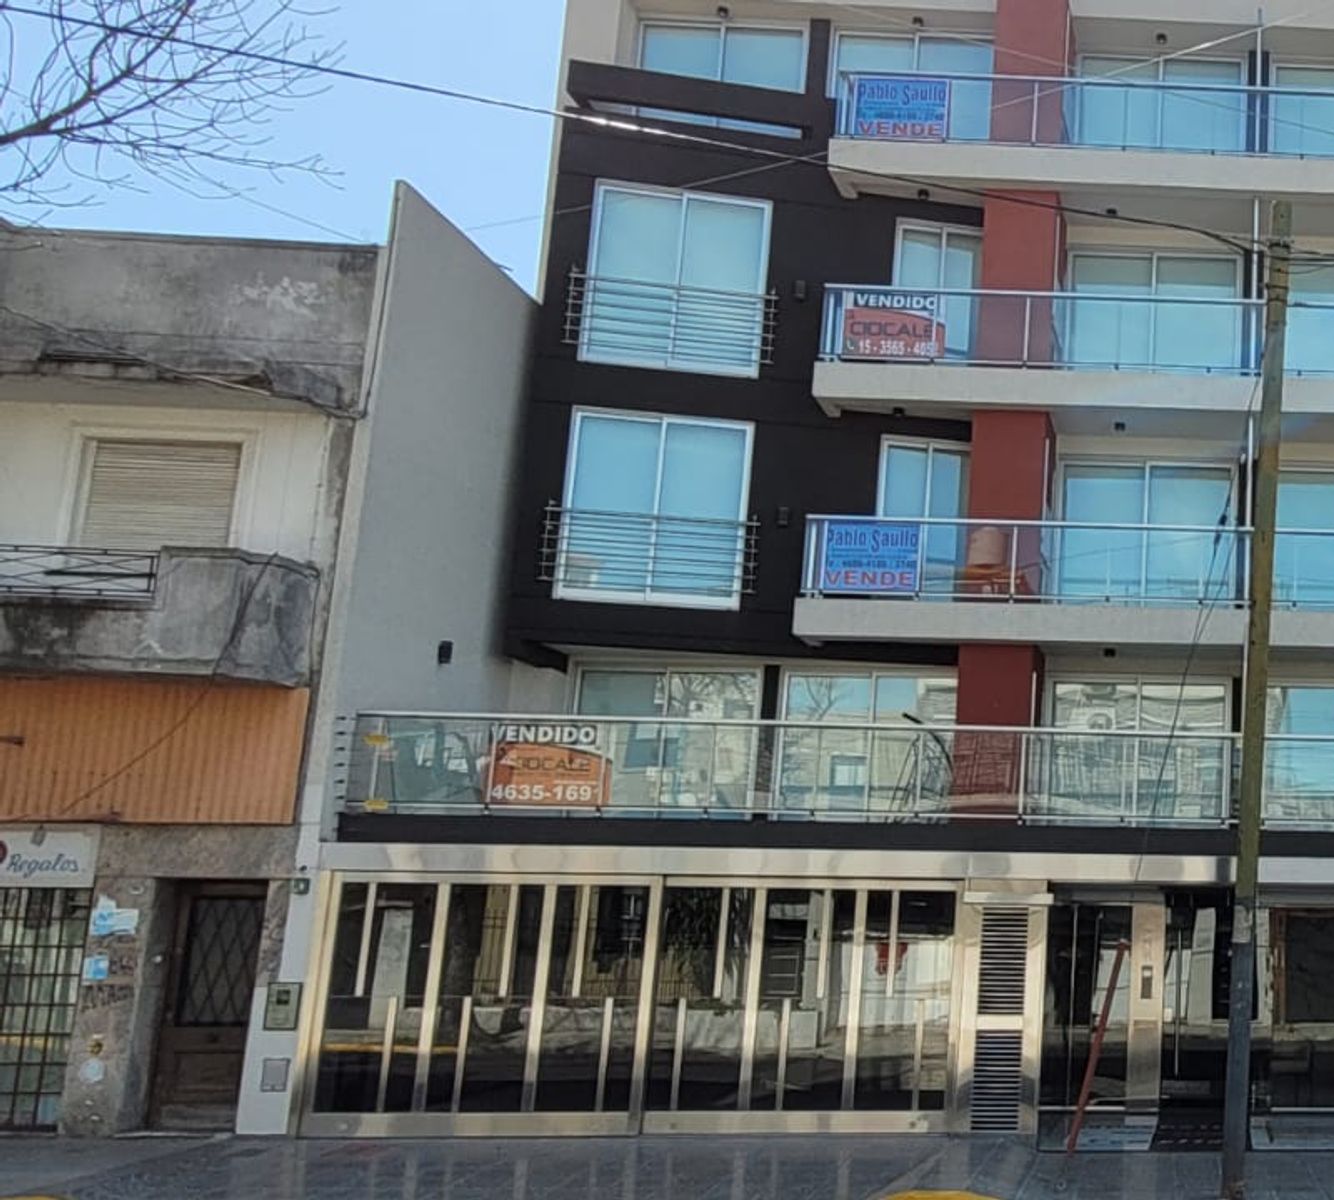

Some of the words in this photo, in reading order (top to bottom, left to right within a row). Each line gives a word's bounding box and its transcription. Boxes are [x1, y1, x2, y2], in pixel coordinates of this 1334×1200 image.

[858, 82, 897, 100] Pablo
[859, 121, 941, 136] VENDE
[856, 292, 937, 310] VENDIDO
[859, 339, 871, 354] 15
[827, 529, 867, 547] Pablo
[872, 529, 918, 552] Saullo
[825, 569, 913, 587] VENDE
[490, 725, 597, 743] VENDIDO
[6, 853, 79, 880] Regalos
